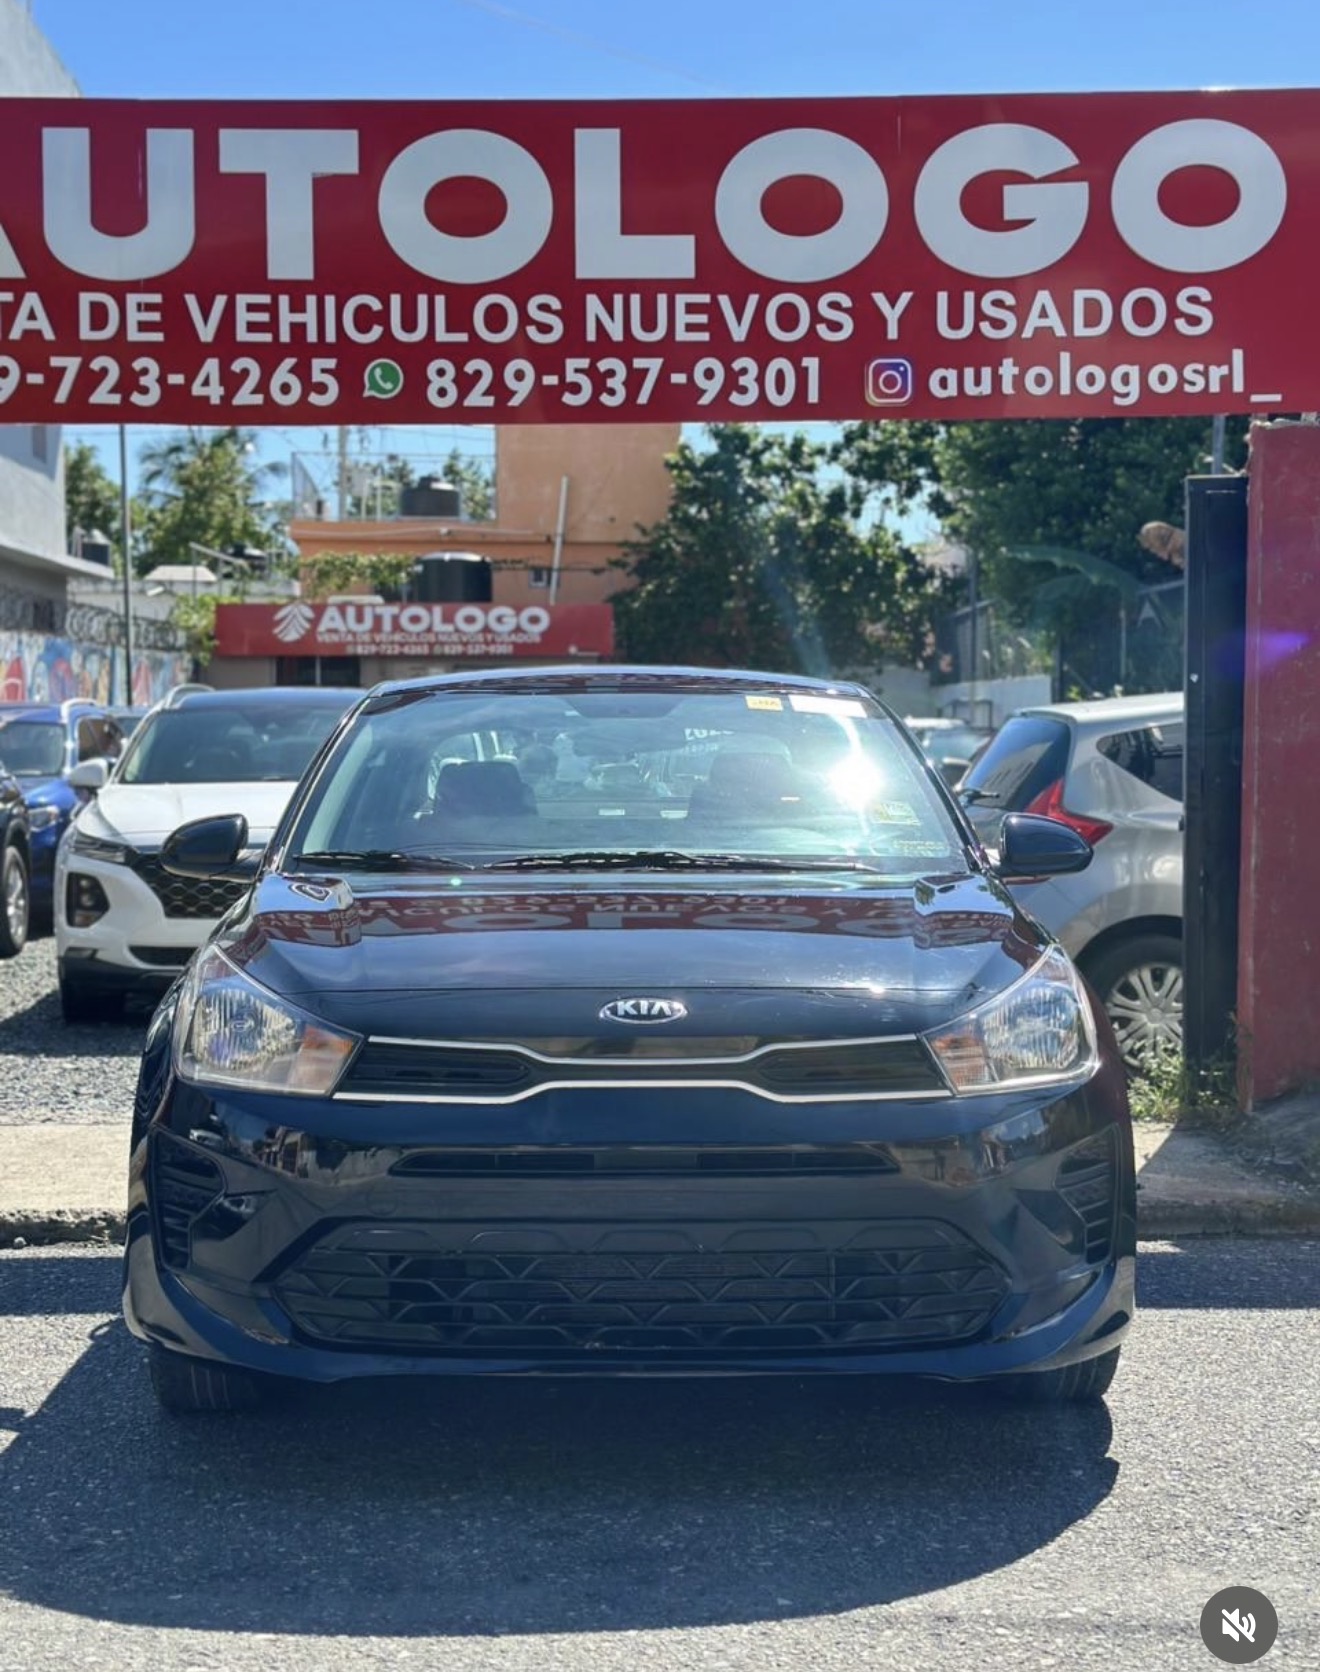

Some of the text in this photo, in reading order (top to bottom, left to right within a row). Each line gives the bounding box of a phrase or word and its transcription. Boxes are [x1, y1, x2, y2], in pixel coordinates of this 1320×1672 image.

[0, 119, 1287, 283] UTOLOGO
[80, 293, 163, 341] DE
[185, 293, 563, 343] VEHICULOS
[587, 293, 853, 342] NUEVOS
[872, 292, 913, 339] Y
[937, 287, 1214, 340] USADOS
[427, 356, 820, 407] 829-537-9301
[929, 349, 1283, 406] autologosrl_
[316, 632, 353, 643] VENTA
[438, 632, 484, 643] NUEVOS
[318, 606, 549, 632] AUTOLOGO
